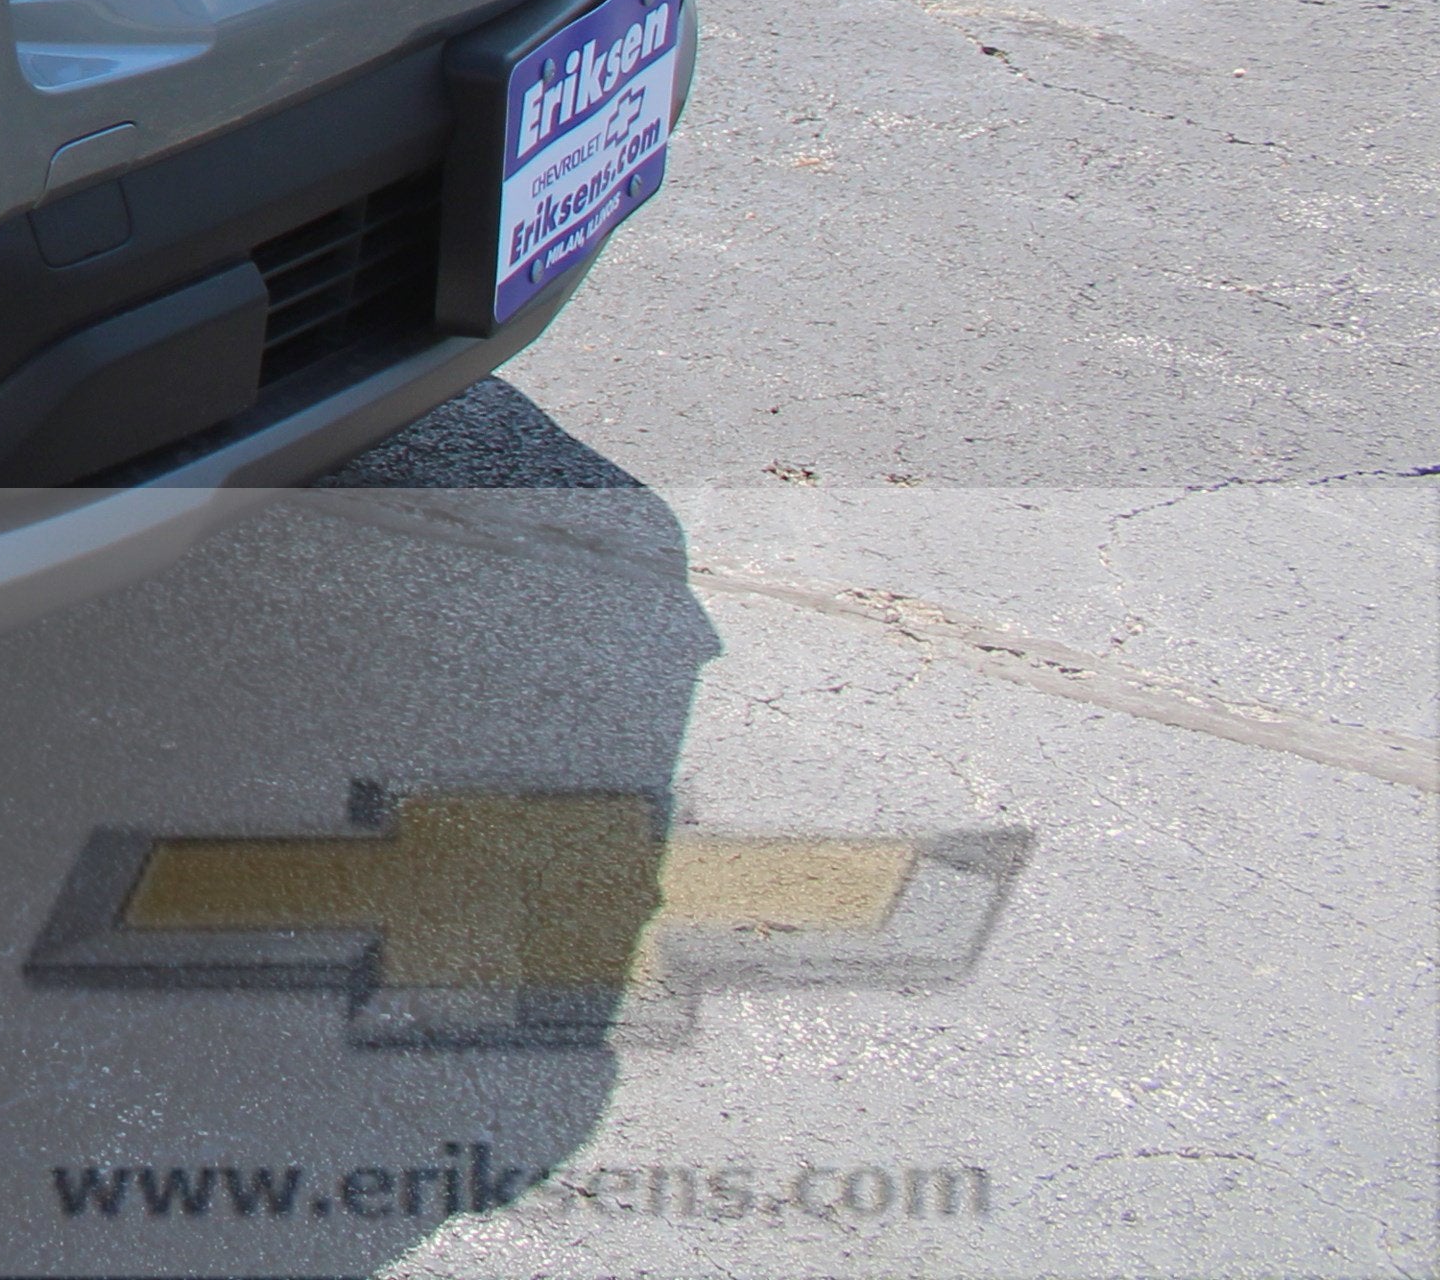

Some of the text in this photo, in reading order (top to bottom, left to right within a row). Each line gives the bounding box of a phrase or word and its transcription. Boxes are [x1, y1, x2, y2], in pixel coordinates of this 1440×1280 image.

[517, 2, 669, 159] Eriksen
[508, 117, 661, 267] Eriksens.com
[531, 132, 602, 199] CHEVROLET
